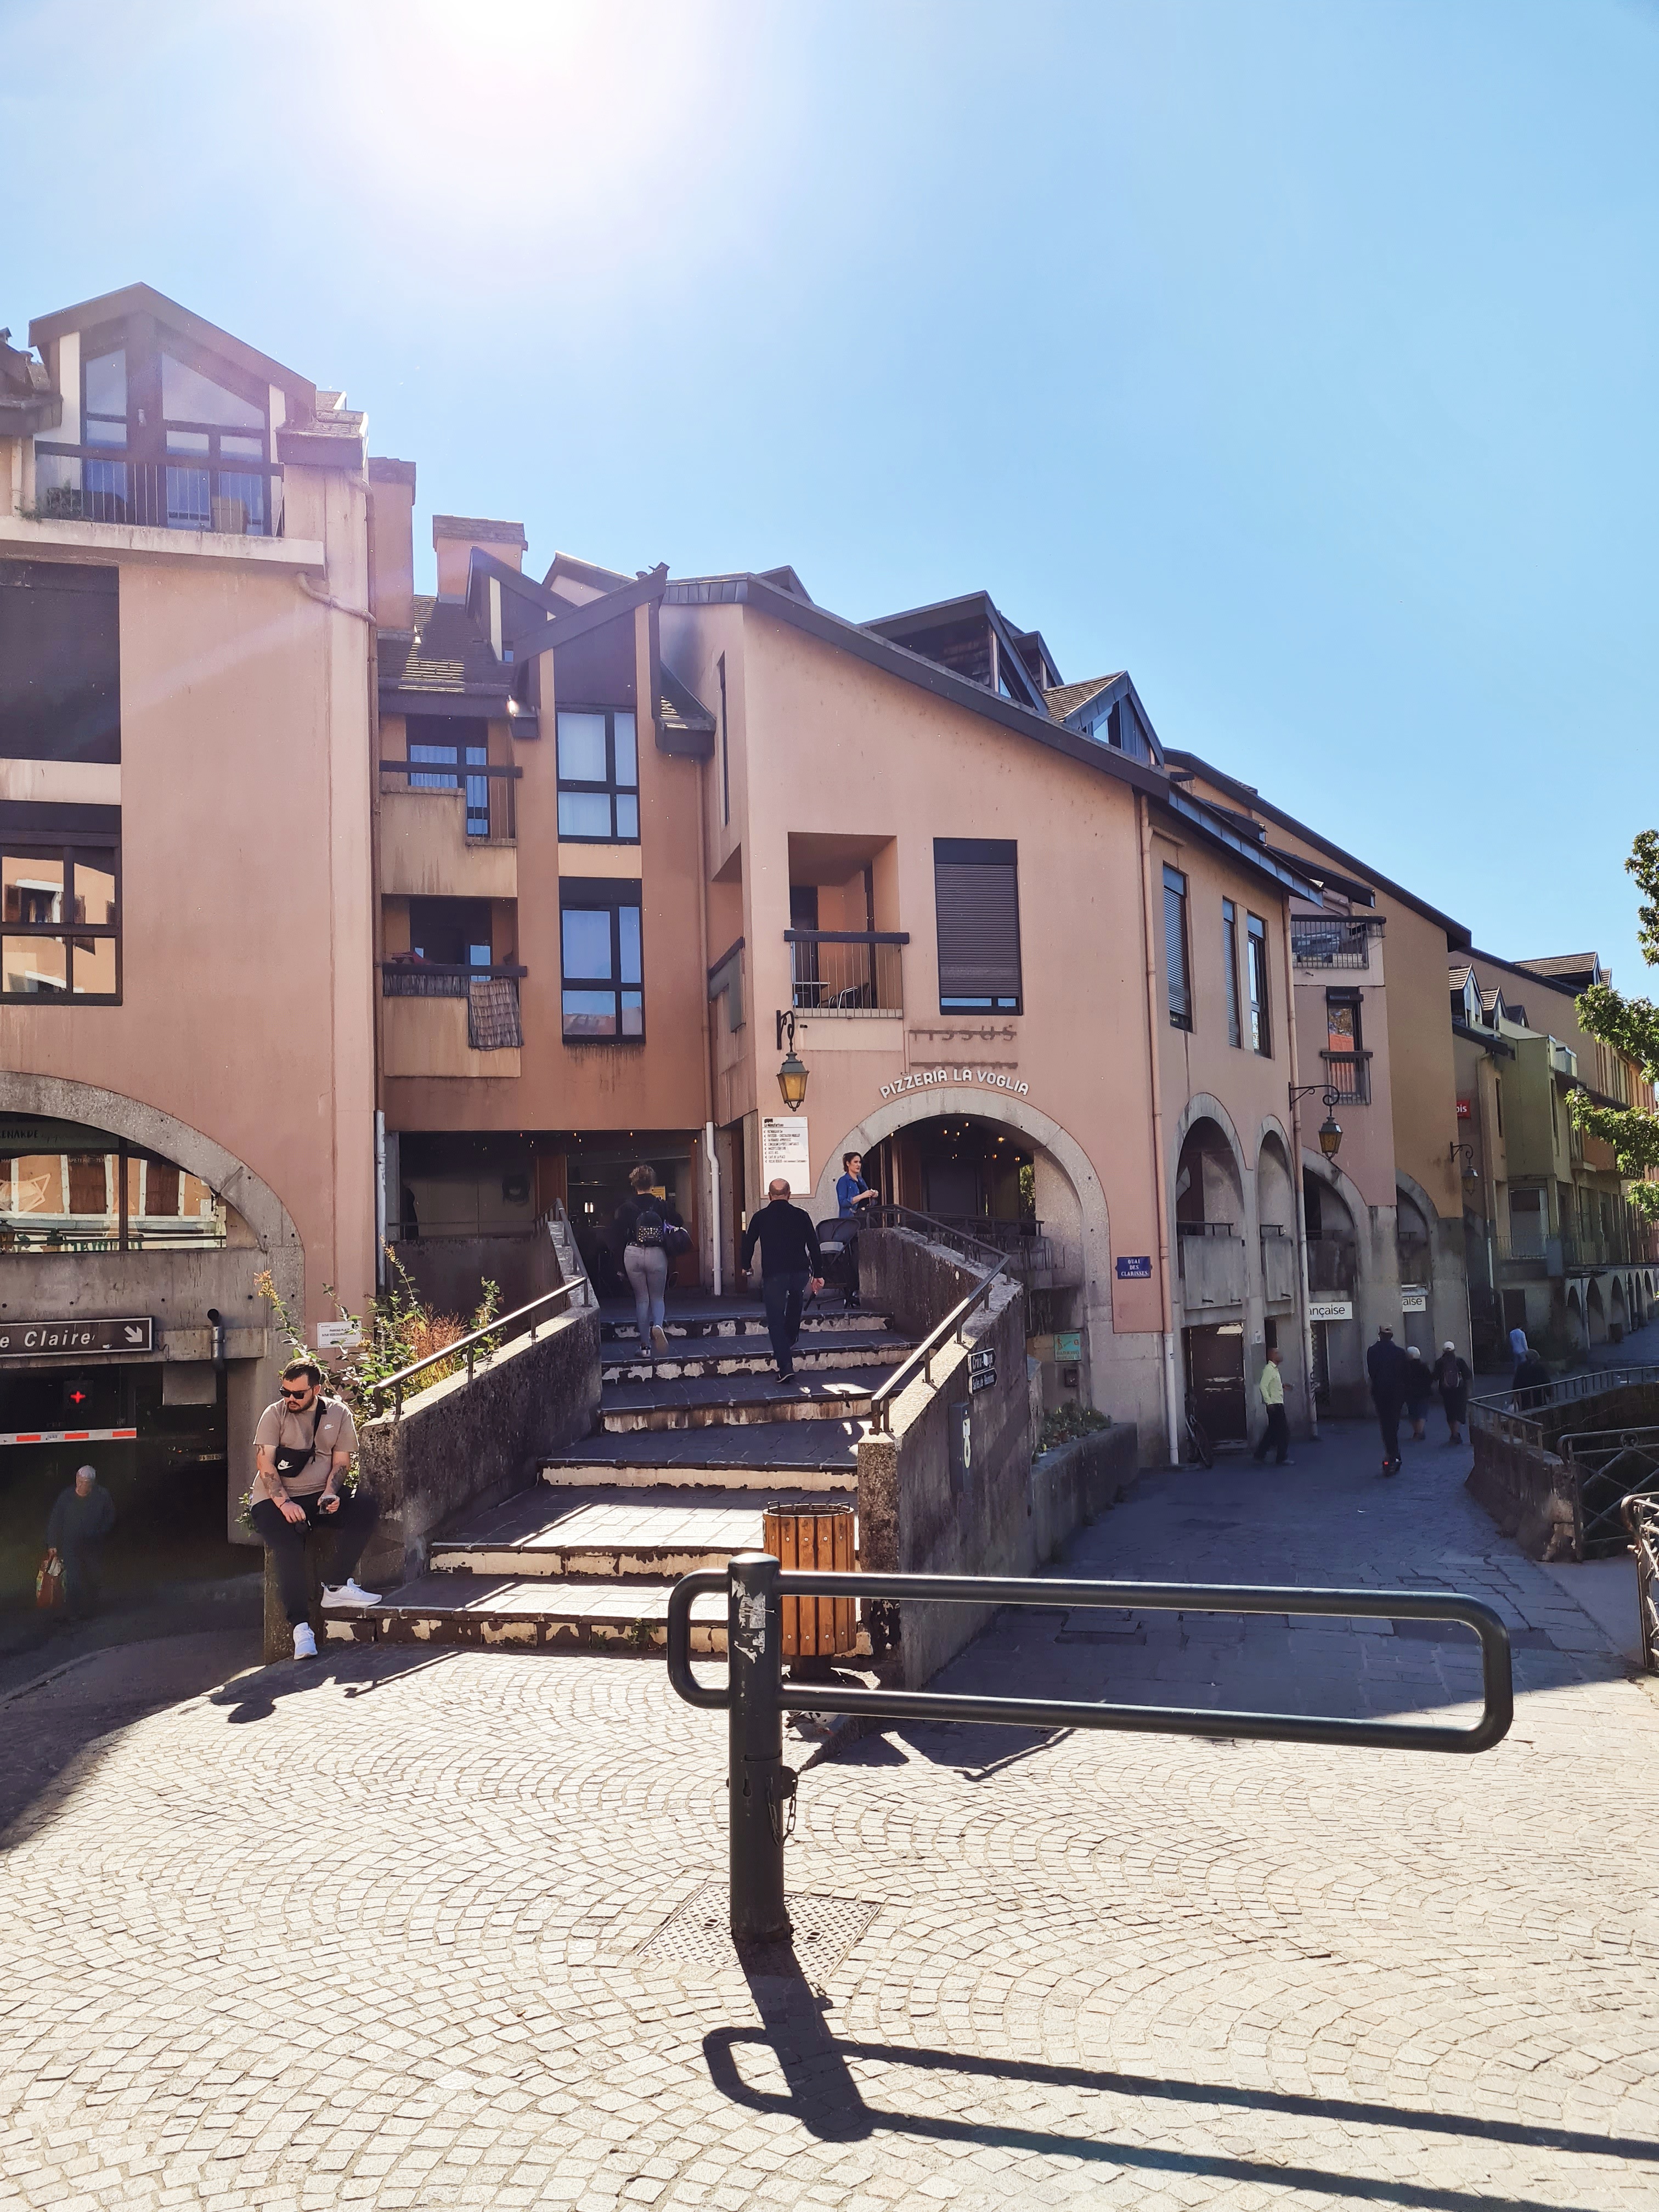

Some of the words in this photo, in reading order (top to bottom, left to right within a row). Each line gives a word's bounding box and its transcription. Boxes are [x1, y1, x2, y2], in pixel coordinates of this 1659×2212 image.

[879, 1070, 947, 1099] PIZZERIA
[953, 1069, 972, 1081] LA
[977, 1070, 1029, 1096] VOGLIA
[24, 1330, 91, 1347] Claire
